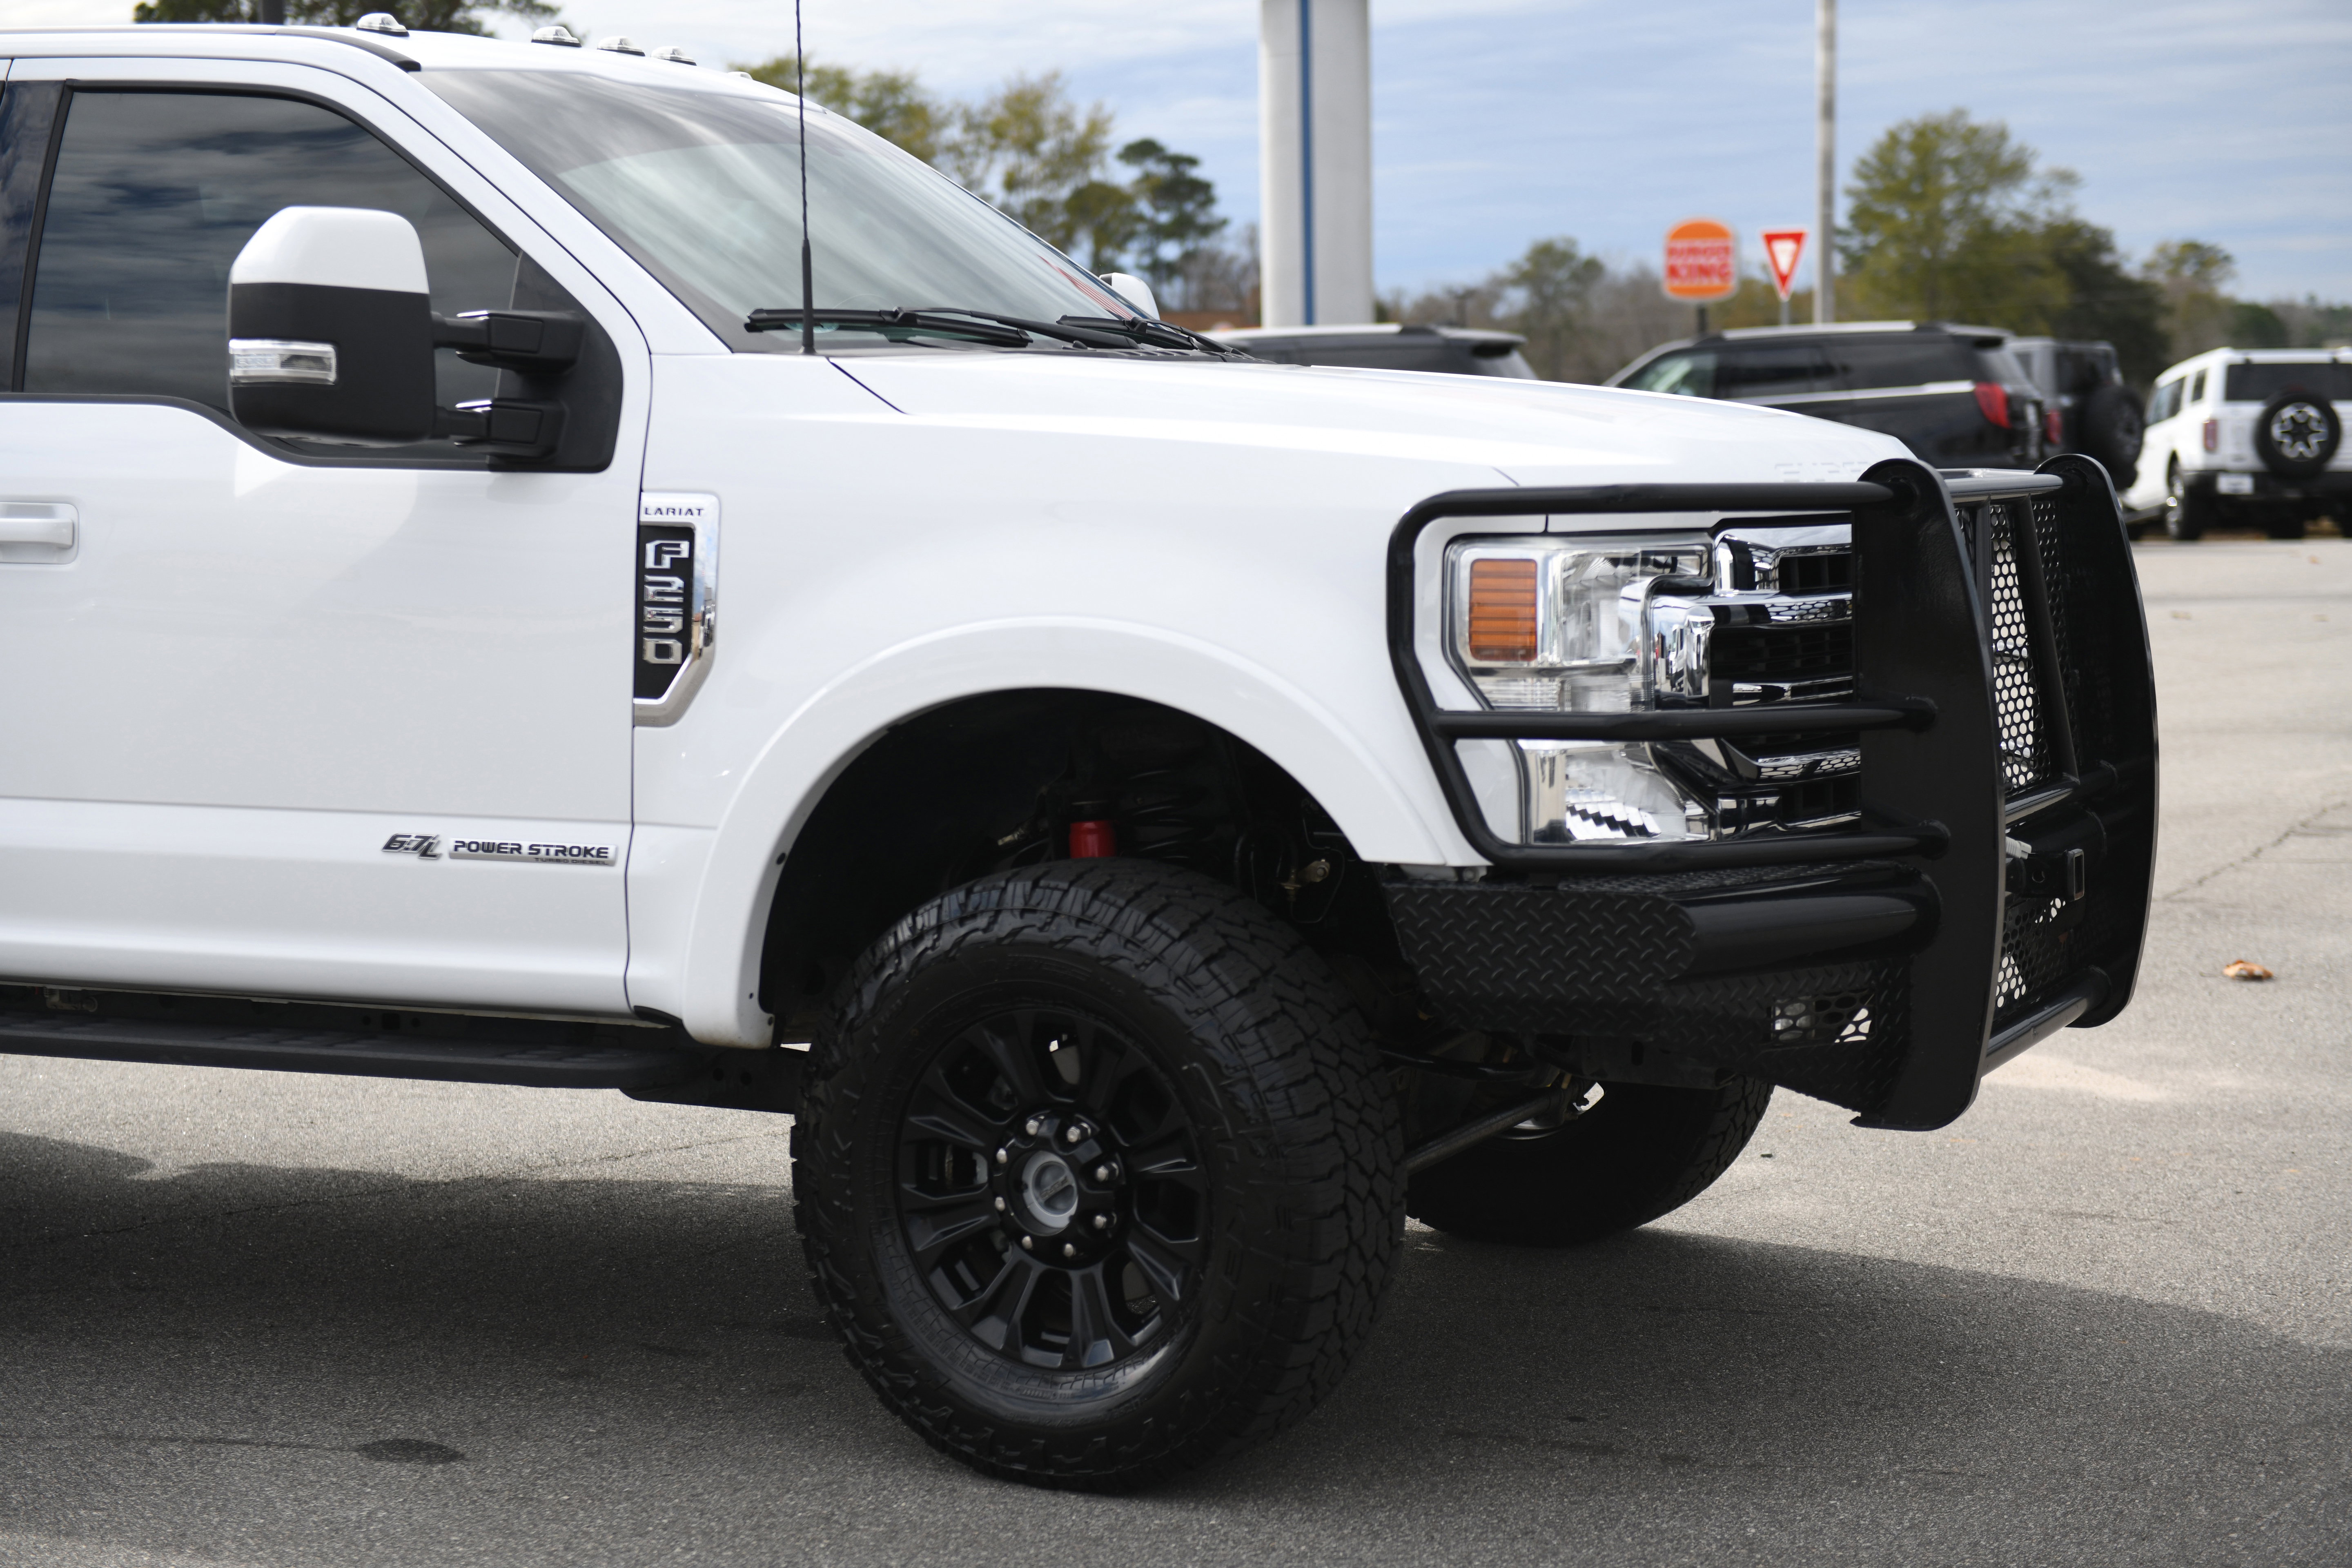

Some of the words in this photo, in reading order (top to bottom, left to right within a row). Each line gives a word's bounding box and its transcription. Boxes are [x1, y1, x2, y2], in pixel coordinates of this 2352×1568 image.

[644, 507, 704, 517] LARIAT
[642, 540, 690, 665] F250
[454, 840, 523, 855] POWER
[528, 844, 608, 858] STROKE
